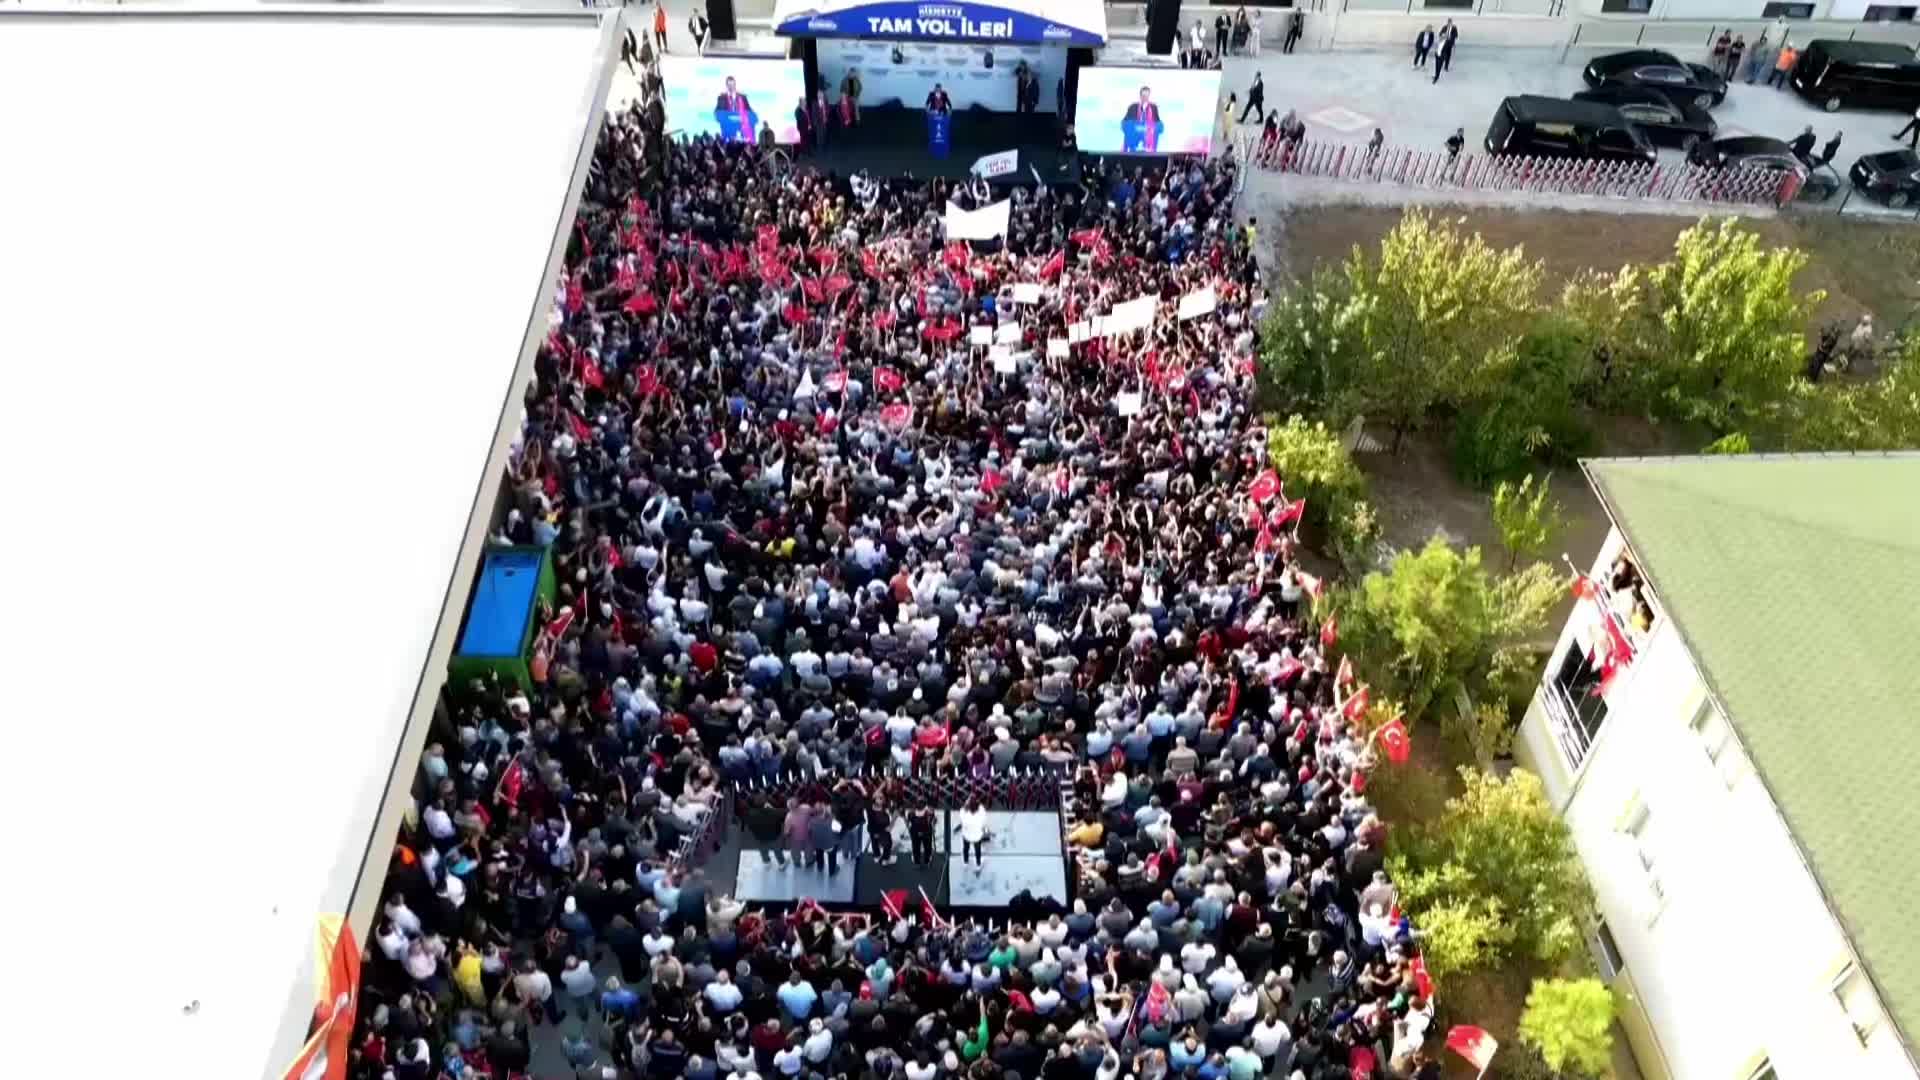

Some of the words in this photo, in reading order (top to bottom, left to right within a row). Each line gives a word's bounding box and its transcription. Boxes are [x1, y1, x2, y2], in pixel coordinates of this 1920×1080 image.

[868, 16, 912, 33] TAM
[917, 18, 956, 35] YOL
[961, 16, 1013, 37] İLERİ
